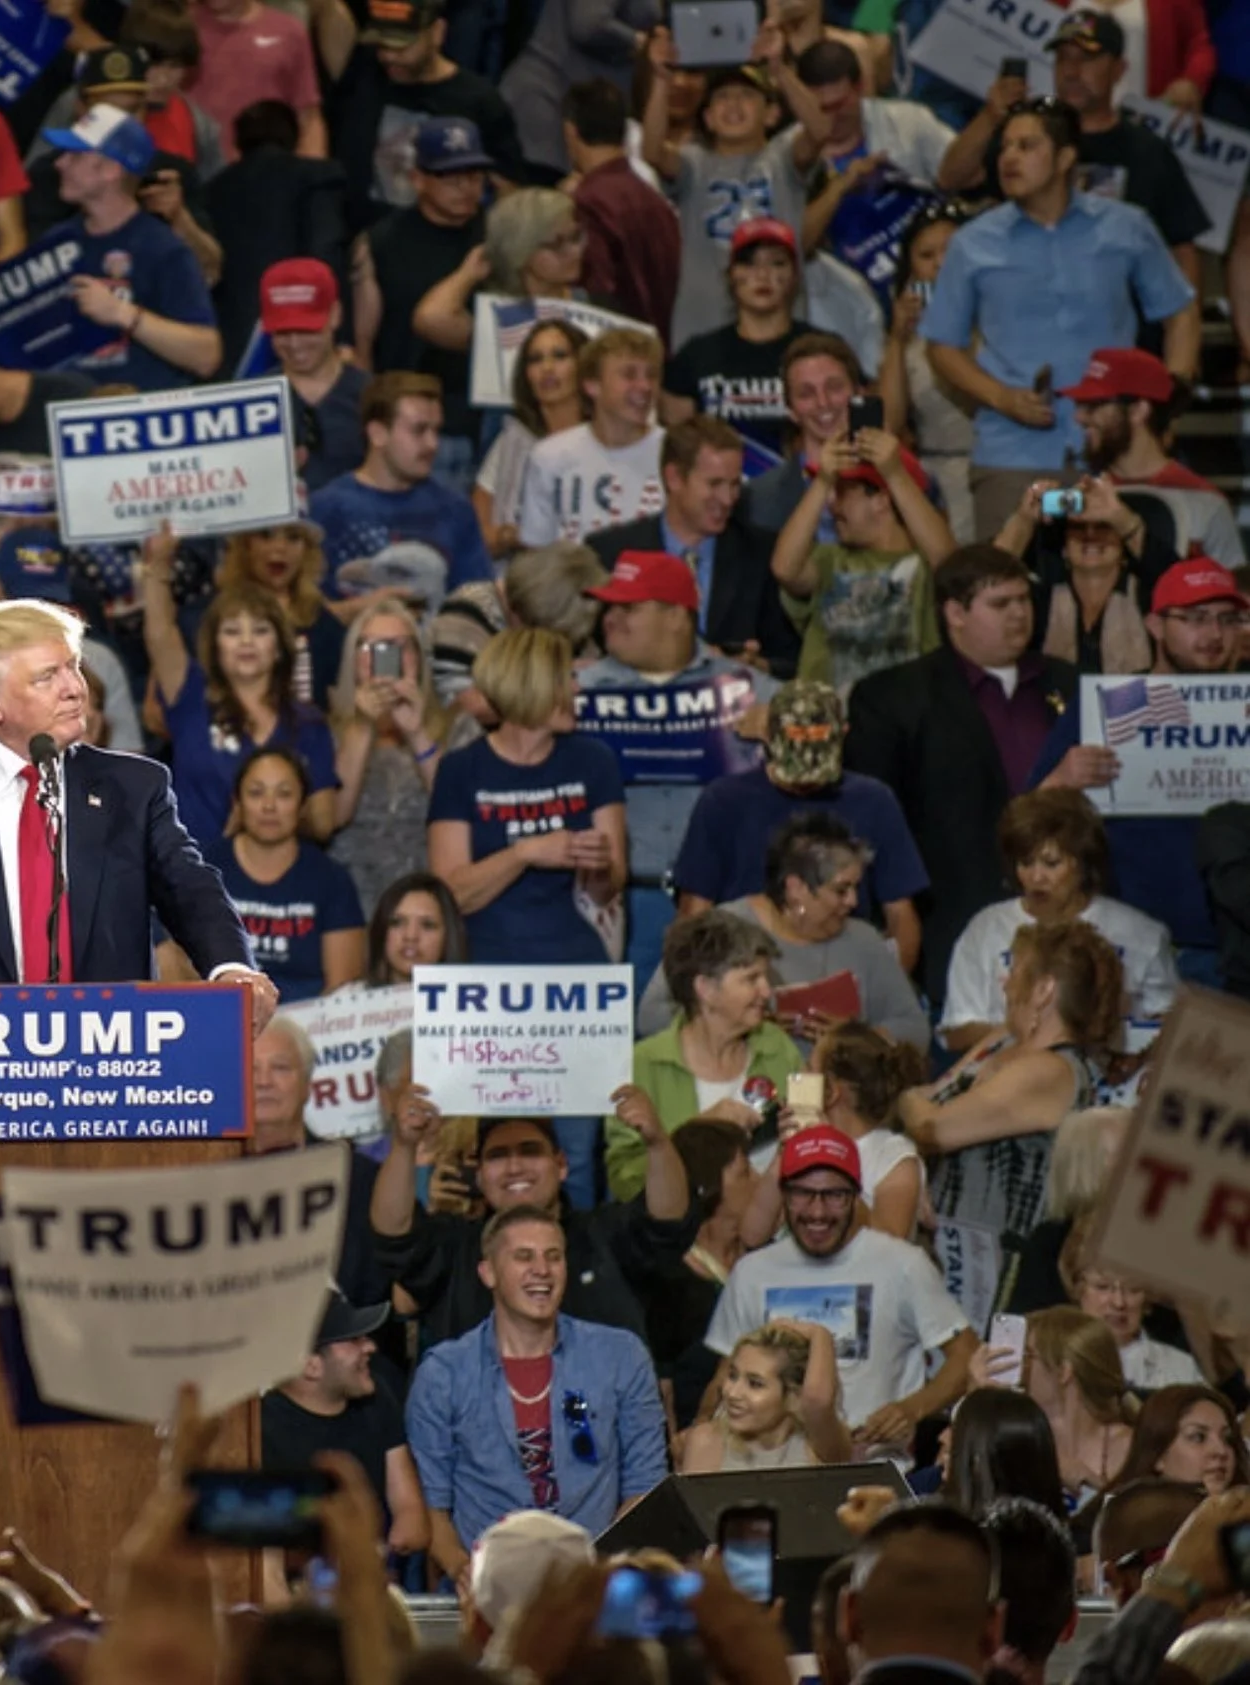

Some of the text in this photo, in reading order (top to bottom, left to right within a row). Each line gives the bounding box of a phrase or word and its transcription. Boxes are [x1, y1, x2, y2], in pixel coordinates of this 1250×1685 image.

[63, 401, 278, 453] TRUMP
[148, 457, 200, 474] MAKE
[107, 466, 248, 502] AMERICA
[574, 680, 750, 718] TRUMP
[1179, 686, 1250, 701] VETERA
[1138, 725, 1250, 749] TRUM
[1149, 769, 1250, 789] AMERIC
[418, 983, 628, 1012] TRUMP
[418, 1023, 628, 1037] MAKE AMERICA GREAT AGAIN!
[77, 1063, 93, 1077] to
[97, 1061, 162, 1077] 88022
[62, 1086, 118, 1105] New
[124, 1085, 214, 1105] Mexico
[63, 1119, 130, 1137] GREAT
[136, 1118, 209, 1136] AGAIN!
[1157, 1089, 1250, 1160] STA
[16, 1183, 336, 1257] TRUMP
[944, 1226, 963, 1296] STAN
